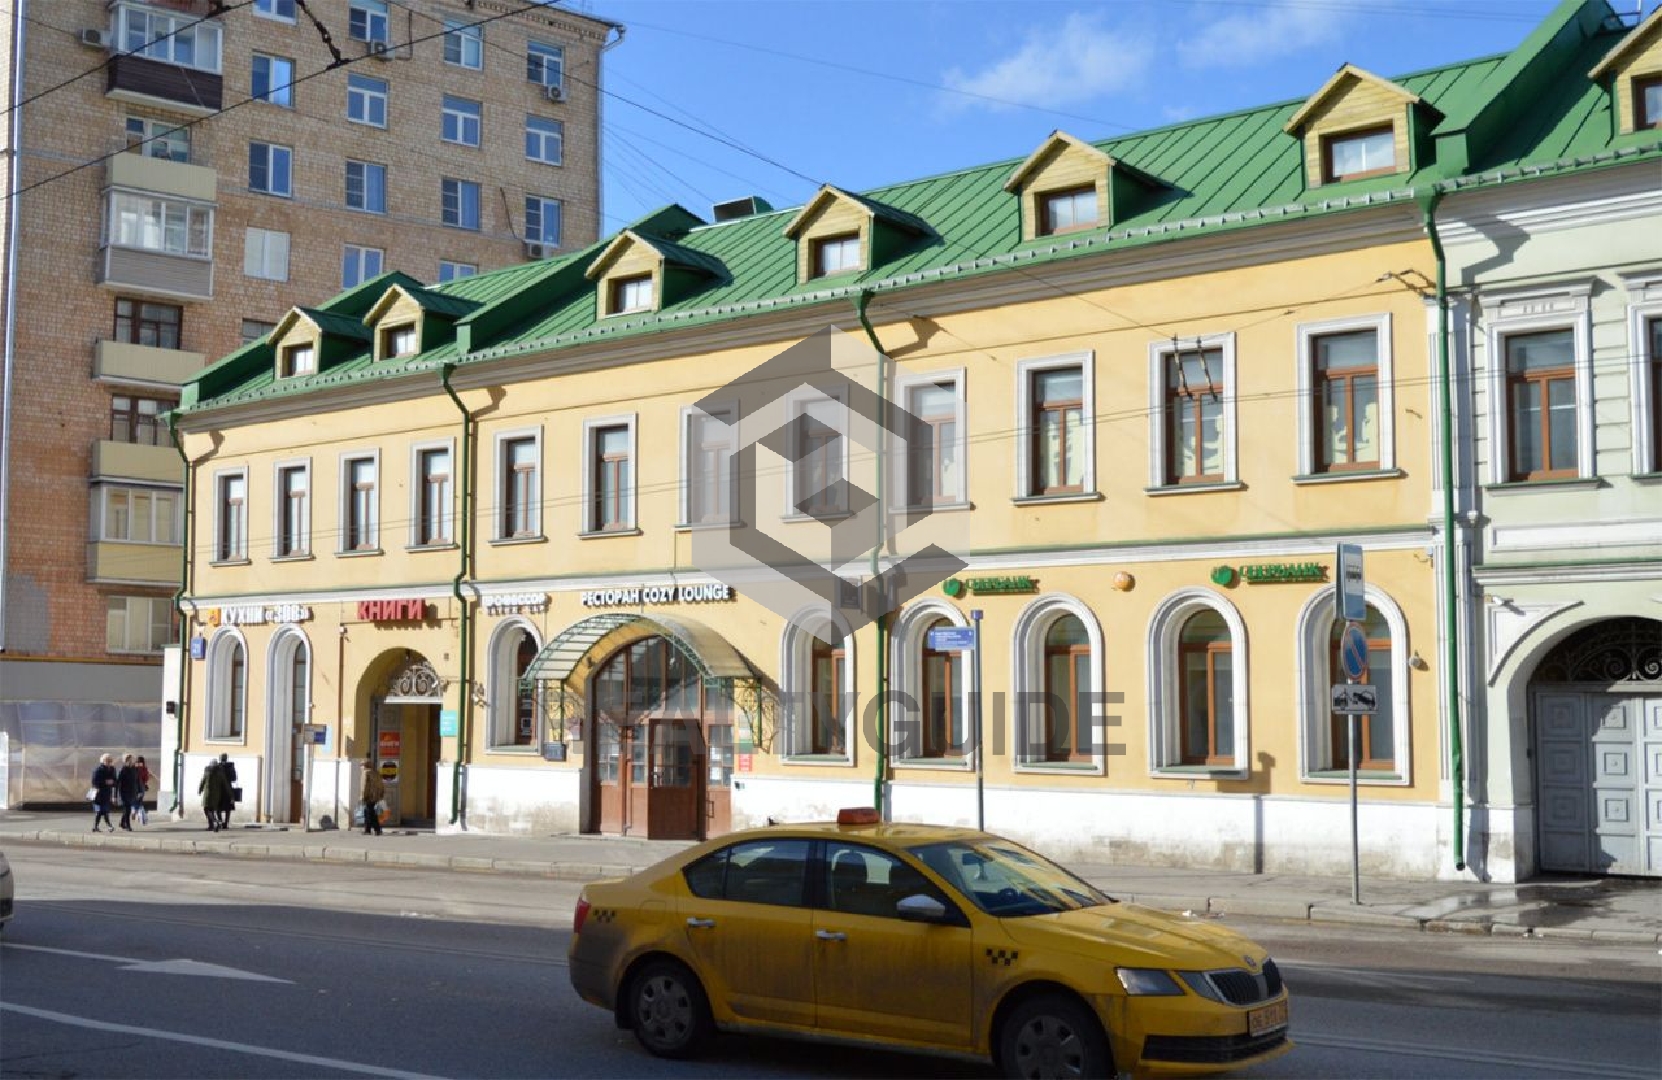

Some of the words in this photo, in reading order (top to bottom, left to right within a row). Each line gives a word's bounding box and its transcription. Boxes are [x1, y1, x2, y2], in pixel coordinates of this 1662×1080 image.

[643, 586, 675, 602] COZY
[679, 583, 730, 601] LOUNGE
[357, 599, 425, 620] КНИГИ
